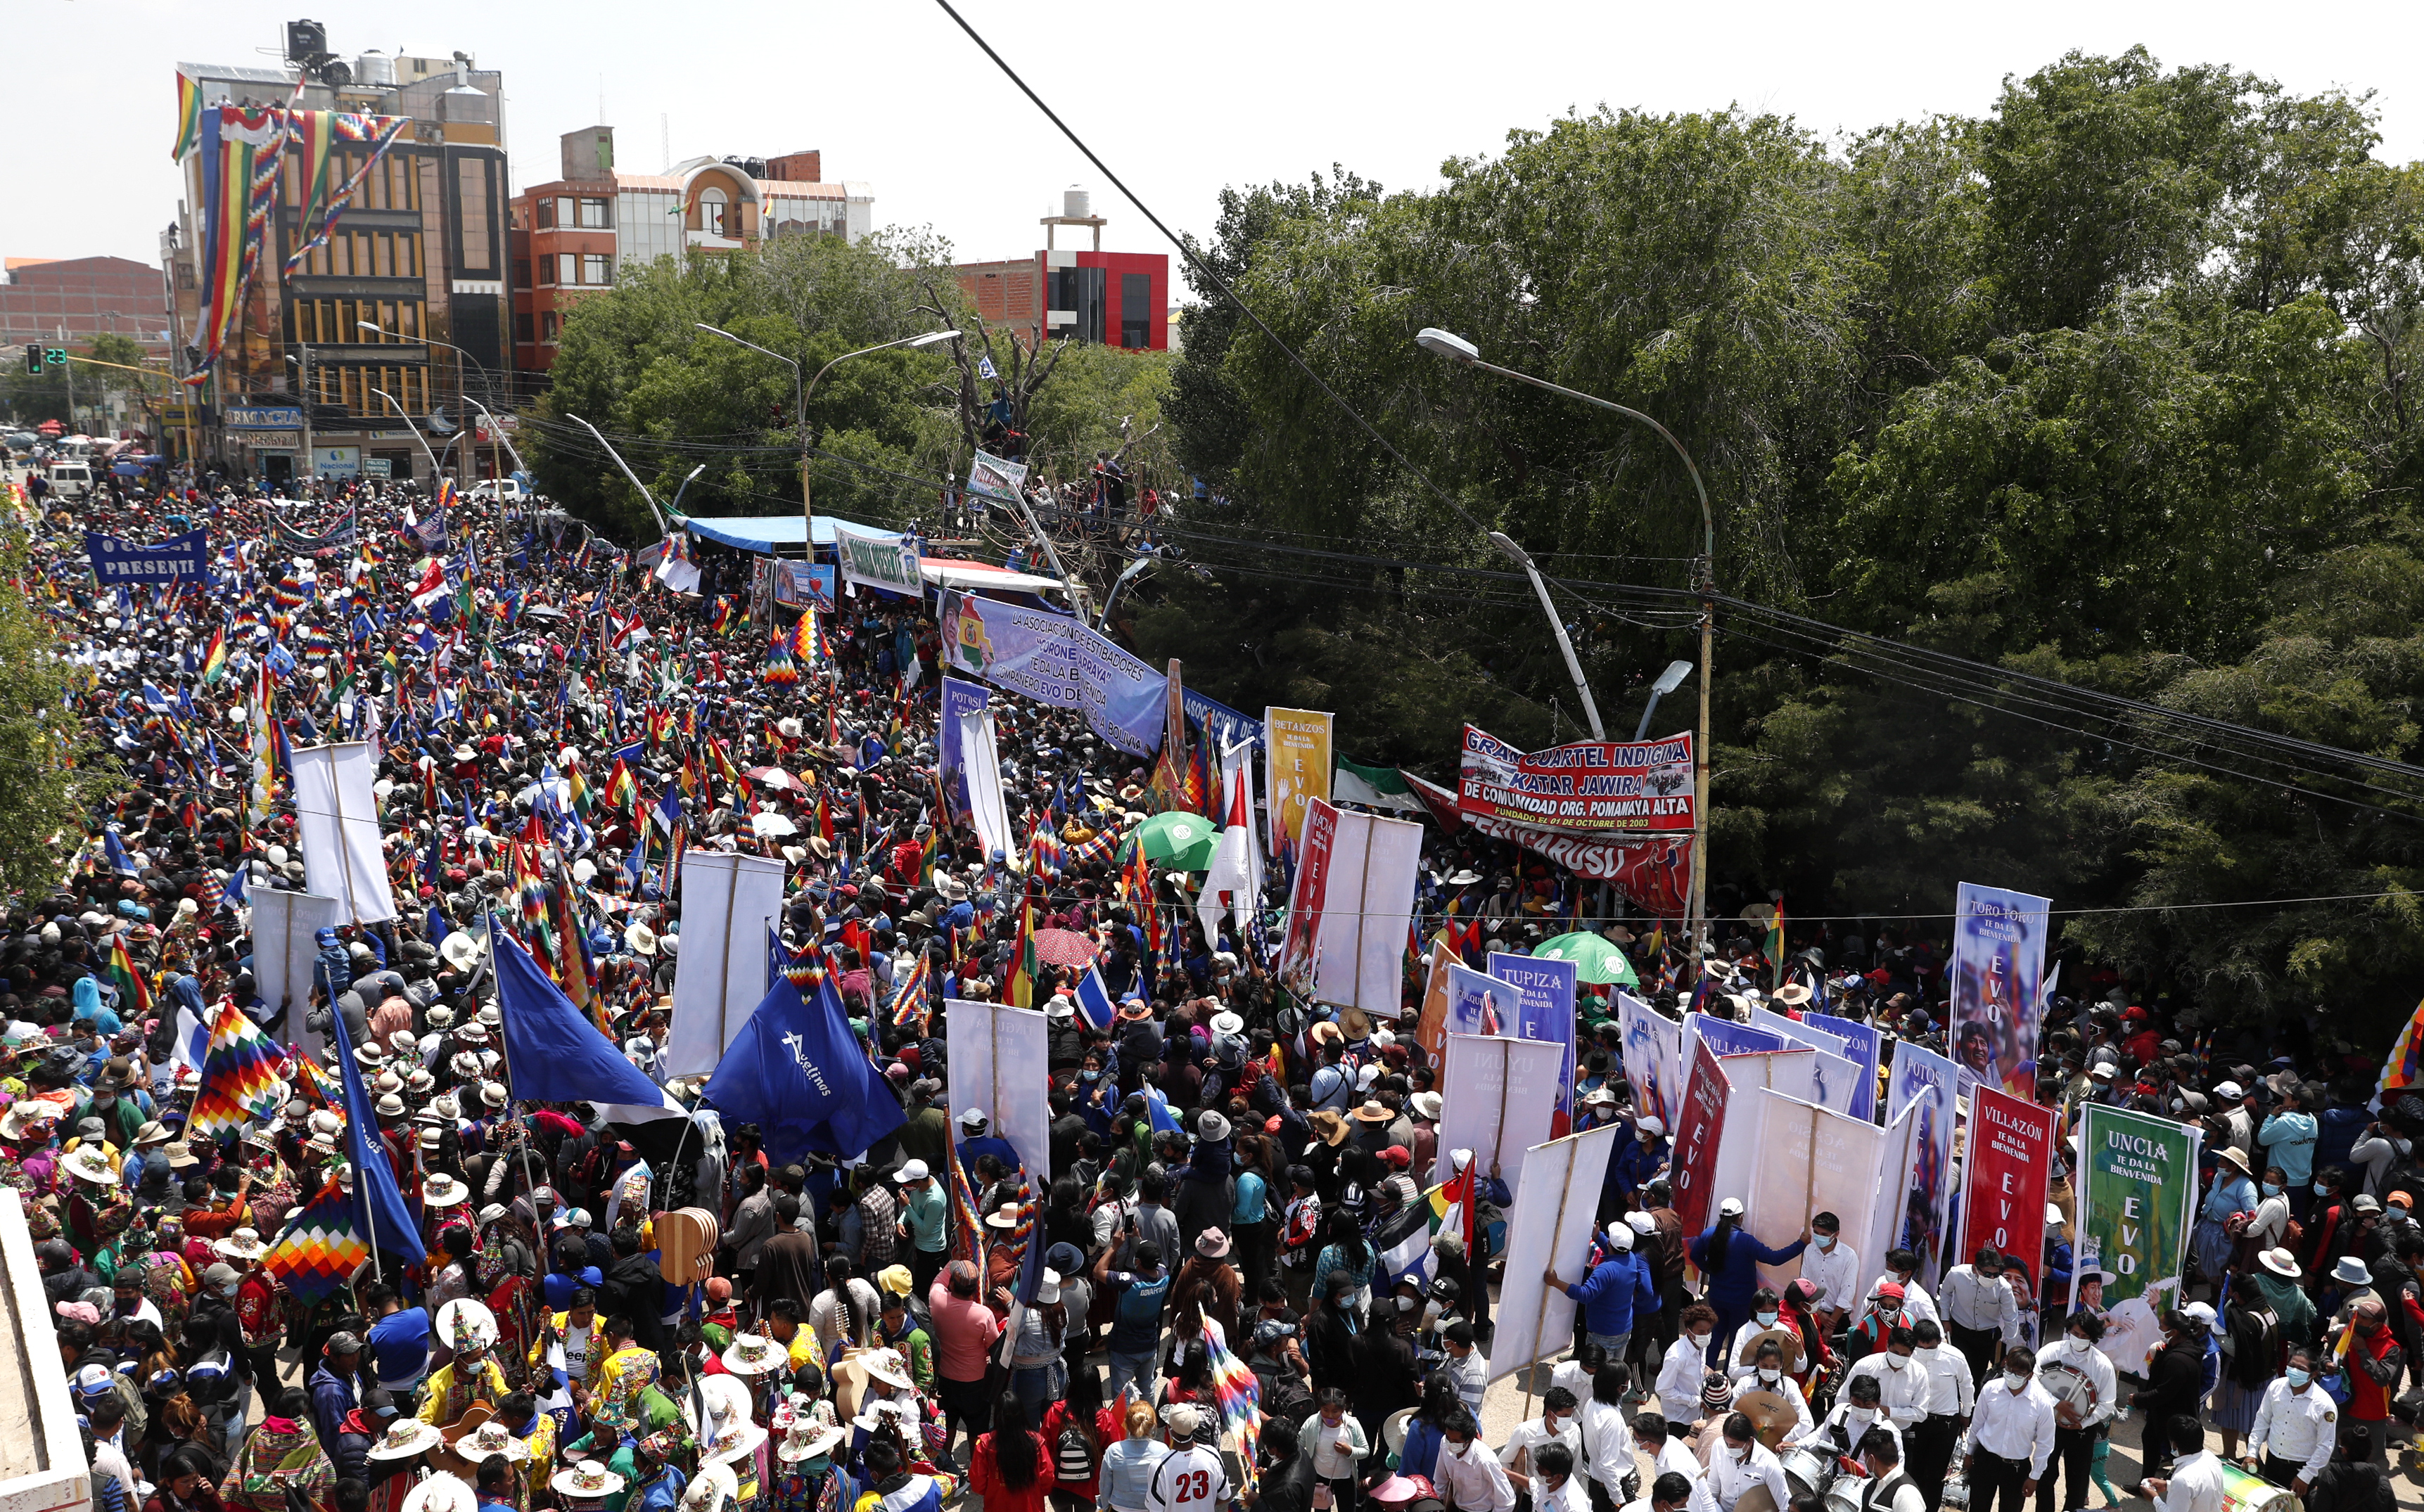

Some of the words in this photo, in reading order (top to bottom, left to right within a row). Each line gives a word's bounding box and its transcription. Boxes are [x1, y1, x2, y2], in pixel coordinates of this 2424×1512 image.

[46, 348, 67, 364] 23
[224, 409, 303, 425] ARMACIA
[104, 559, 196, 575] PRESENTE
[1012, 611, 1022, 625] LA
[1074, 632, 1085, 647] DE
[1085, 638, 1145, 682] ESTIBADORES
[1029, 656, 1038, 670] TE
[1039, 661, 1051, 677] DA
[1052, 666, 1066, 680] LA
[952, 691, 982, 708] POTOSÍ
[995, 665, 1040, 693] COMPAÑERO
[1040, 681, 1061, 699] EVO
[1065, 688, 1082, 702] DE
[1099, 719, 1106, 732] A
[1108, 720, 1142, 750] BOLIVIA
[1185, 698, 1238, 735] ASOCACION
[1241, 722, 1254, 739] DE
[1274, 719, 1325, 734] BETANZOS
[1283, 741, 1315, 750] BIENVENIDA
[1466, 731, 1526, 764] GRAN
[1524, 745, 1609, 768] CUARTEL
[1294, 759, 1306, 807] EVO
[1508, 771, 1575, 796] KATAR
[1578, 774, 1643, 797] JAWIRA
[1464, 783, 1480, 799] DE
[1482, 786, 1558, 816] COMUNIDAD
[1559, 800, 1587, 817] ORG.
[1589, 799, 1650, 817] POMAMAYA
[1652, 797, 1689, 815] ALTA
[1495, 807, 1536, 823] FUNDADO
[1537, 816, 1548, 824] EL
[1549, 816, 1562, 826] 01
[1562, 817, 1574, 826] DE
[1575, 818, 1616, 828] OCTUBRE
[1616, 819, 1628, 828] DE
[1628, 819, 1649, 827] 2003
[1306, 861, 1320, 921] EVO
[1971, 900, 2000, 917] TORO
[2003, 908, 2035, 924] TORO
[1979, 928, 2022, 944] BIENVENIDA
[1984, 919, 1994, 928] TE
[1994, 921, 2005, 931] DA
[2006, 924, 2016, 934] LA
[1503, 968, 1564, 990] TUPIZA
[1987, 954, 2003, 1023] EVO
[1457, 989, 1510, 1018] COLQUEHACA
[1520, 997, 1553, 1009] ENVENIDA
[1526, 990, 1536, 999] DA
[1470, 1007, 1477, 1016] TE
[1906, 1057, 1946, 1089] POTOSÍ
[1913, 1080, 1920, 1089] TE
[1984, 1105, 2043, 1142] VILLAZÓN
[1991, 1140, 2030, 1163] BIENVENIDA
[1997, 1131, 2007, 1141] TE
[2007, 1134, 2016, 1145] DA
[2017, 1139, 2026, 1150] LA
[2108, 1129, 2169, 1162] UNCIA
[1680, 1121, 1704, 1190] EVO
[2116, 1154, 2127, 1164] TE
[2129, 1157, 2143, 1170] DA
[2145, 1161, 2156, 1172] LA
[2110, 1164, 2162, 1186] BIENVENIDA
[1995, 1172, 2014, 1249] EVO
[2117, 1196, 2141, 1275] EVO
[566, 1352, 587, 1363] eep
[1175, 1469, 1209, 1504] 23
